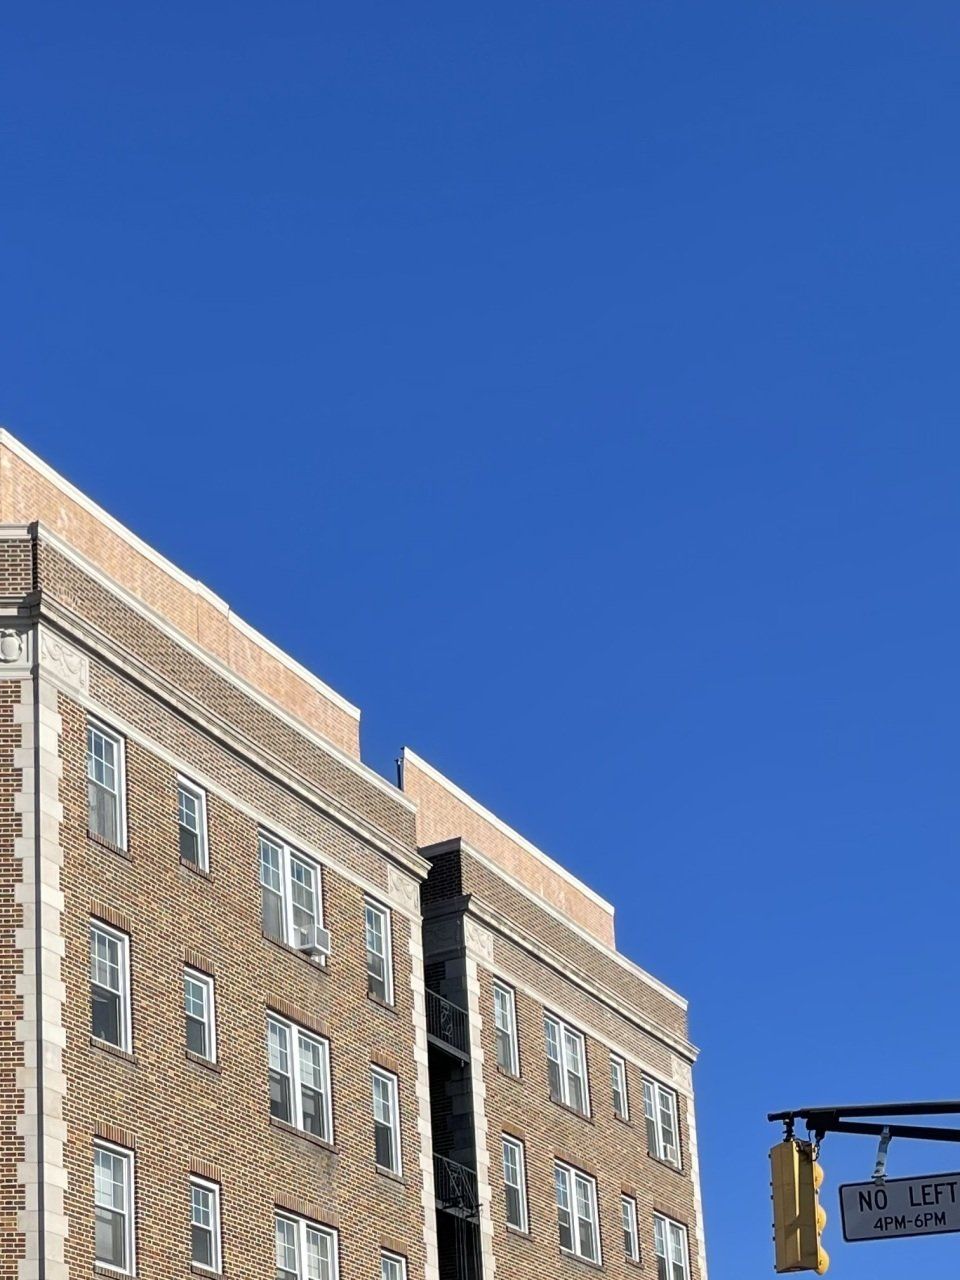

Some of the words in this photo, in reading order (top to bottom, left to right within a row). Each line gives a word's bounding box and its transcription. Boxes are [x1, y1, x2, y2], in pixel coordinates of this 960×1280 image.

[858, 1188, 888, 1212] NO
[908, 1181, 958, 1207] LEFT
[873, 1211, 947, 1232] 4PM-6PM
